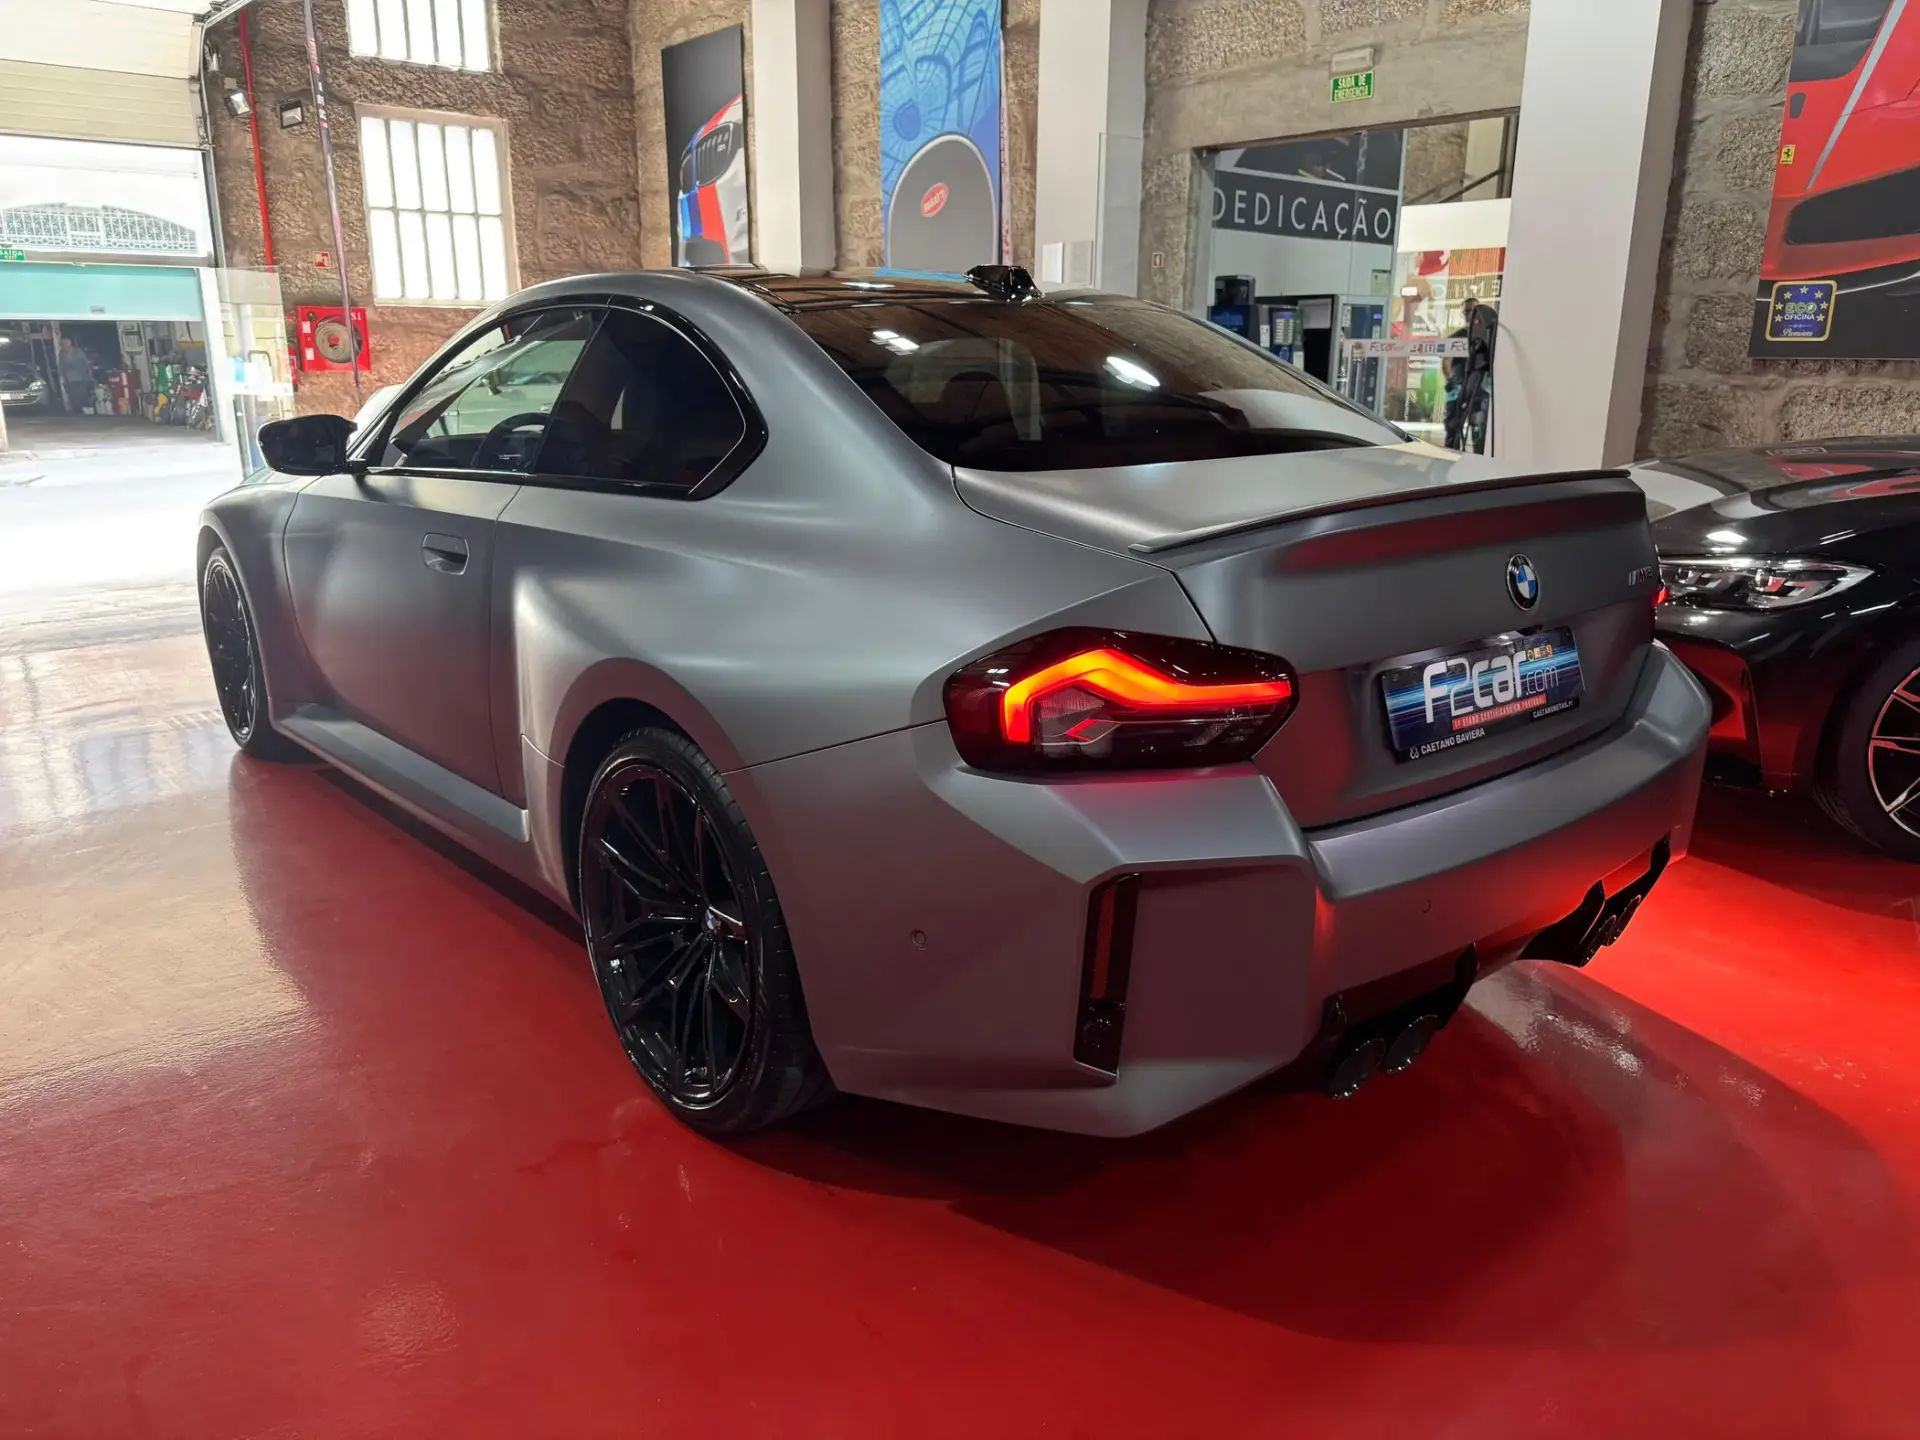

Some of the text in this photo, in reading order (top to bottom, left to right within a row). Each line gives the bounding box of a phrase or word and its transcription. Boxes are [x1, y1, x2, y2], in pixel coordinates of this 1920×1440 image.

[1213, 187, 1392, 240] DEDICAÇÃO
[1783, 313, 1815, 321] OFICINA
[1785, 302, 1817, 314] ECO
[1421, 727, 1486, 755] CAETANO BAVIERA
